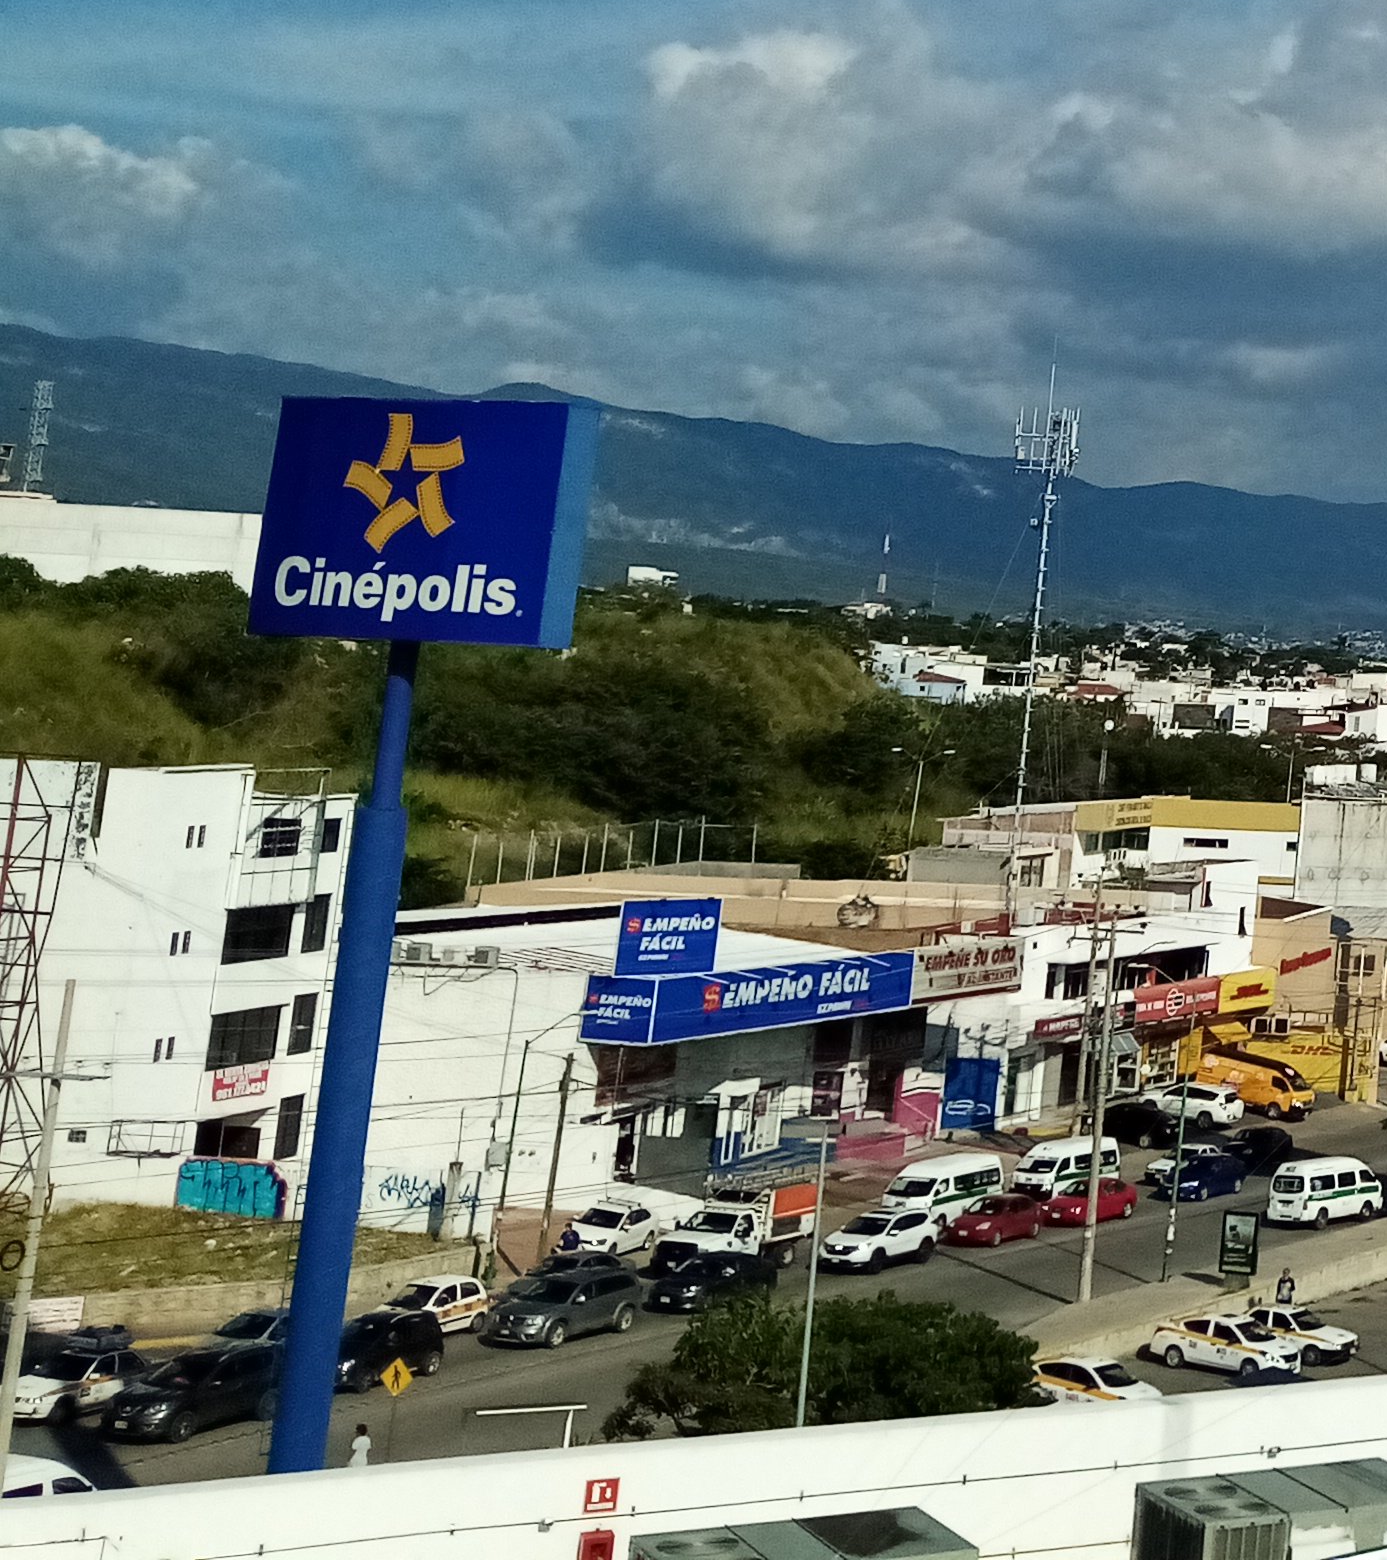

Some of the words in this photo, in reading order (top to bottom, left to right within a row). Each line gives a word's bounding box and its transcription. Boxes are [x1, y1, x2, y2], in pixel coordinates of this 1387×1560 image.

[275, 555, 517, 622] Cinépolis
[641, 913, 716, 932] EMPEÑO
[639, 932, 686, 951] FÁCIL
[721, 970, 815, 1009] EMPEÑO
[818, 963, 871, 996] FÁCIL
[599, 994, 652, 1008] EMPEÑO
[597, 1006, 631, 1019] FÁCIL
[1290, 1044, 1334, 1056] DHL
